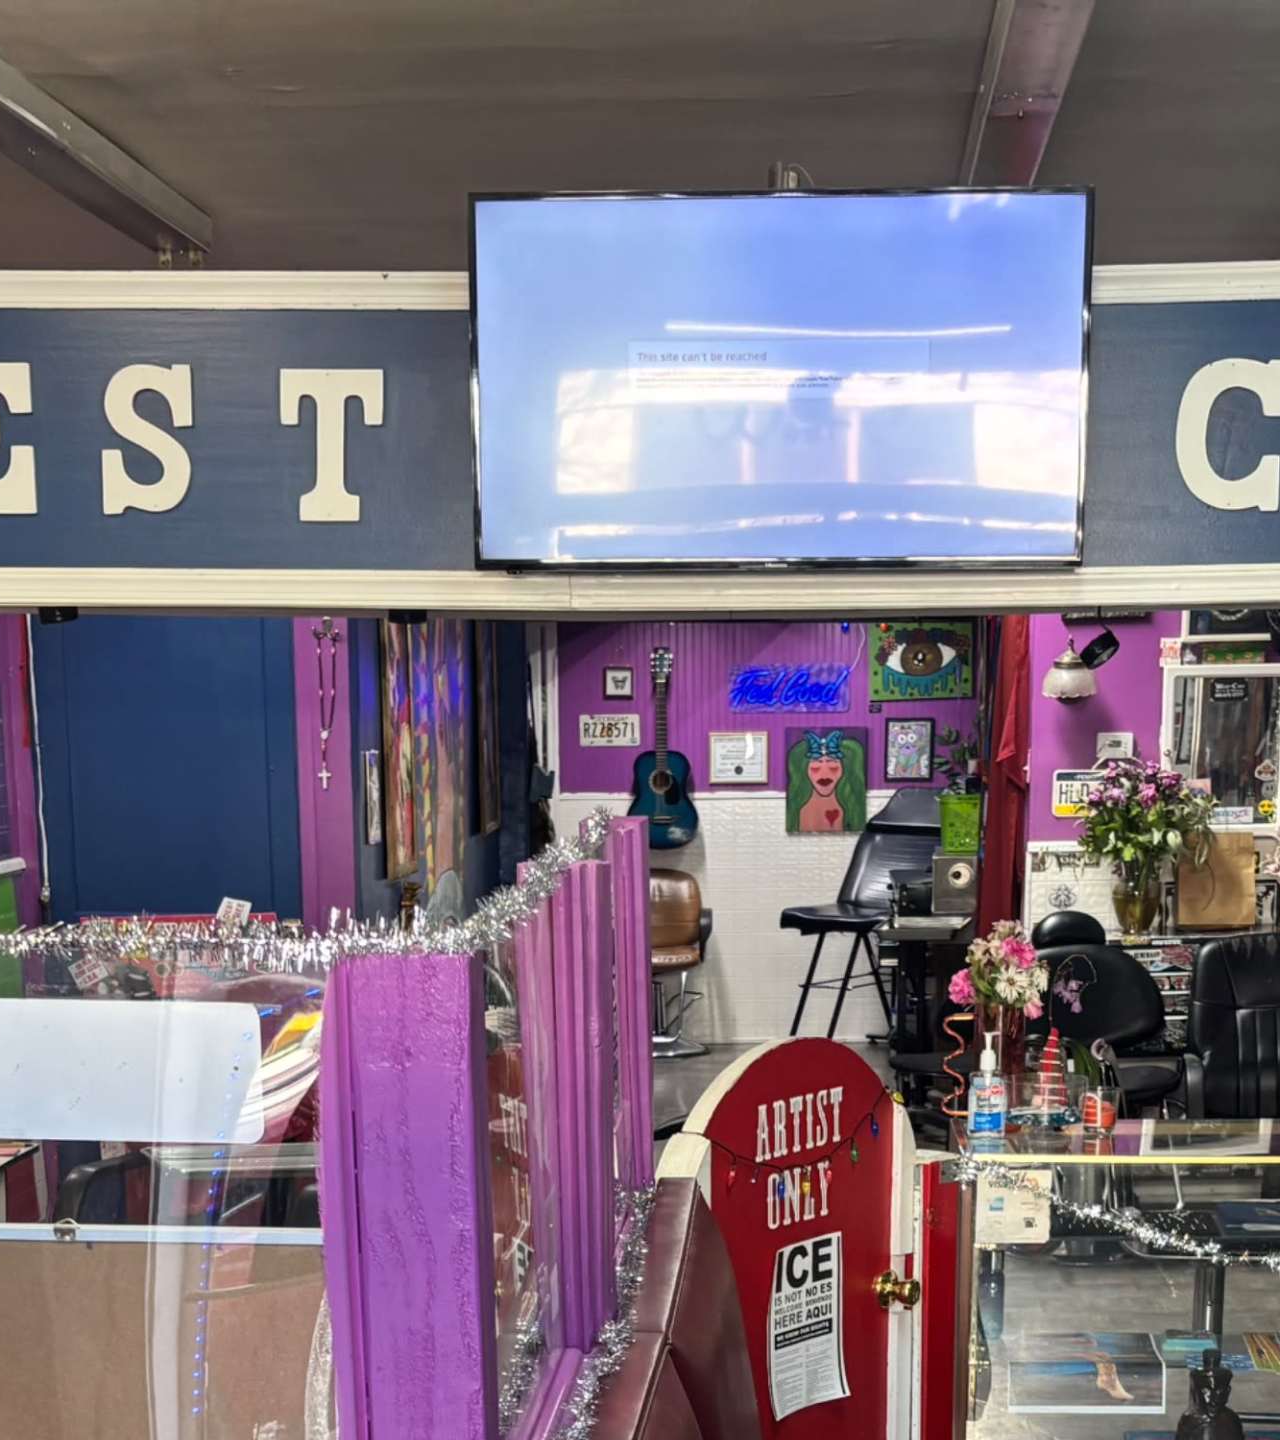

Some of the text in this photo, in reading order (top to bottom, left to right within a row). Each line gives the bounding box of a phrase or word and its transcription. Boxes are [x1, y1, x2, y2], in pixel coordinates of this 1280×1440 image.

[660, 352, 679, 362] site
[681, 352, 708, 362] can't
[710, 352, 723, 362] be
[726, 352, 768, 362] reached
[783, 668, 850, 706] Good
[755, 1086, 844, 1163] ARTIST
[766, 1160, 832, 1231] ONLY
[775, 1238, 833, 1294] ICE
[784, 1290, 802, 1304] NOT
[805, 1282, 832, 1298] NO ES
[774, 1312, 803, 1331] HERE
[805, 1302, 832, 1322] AQUI
